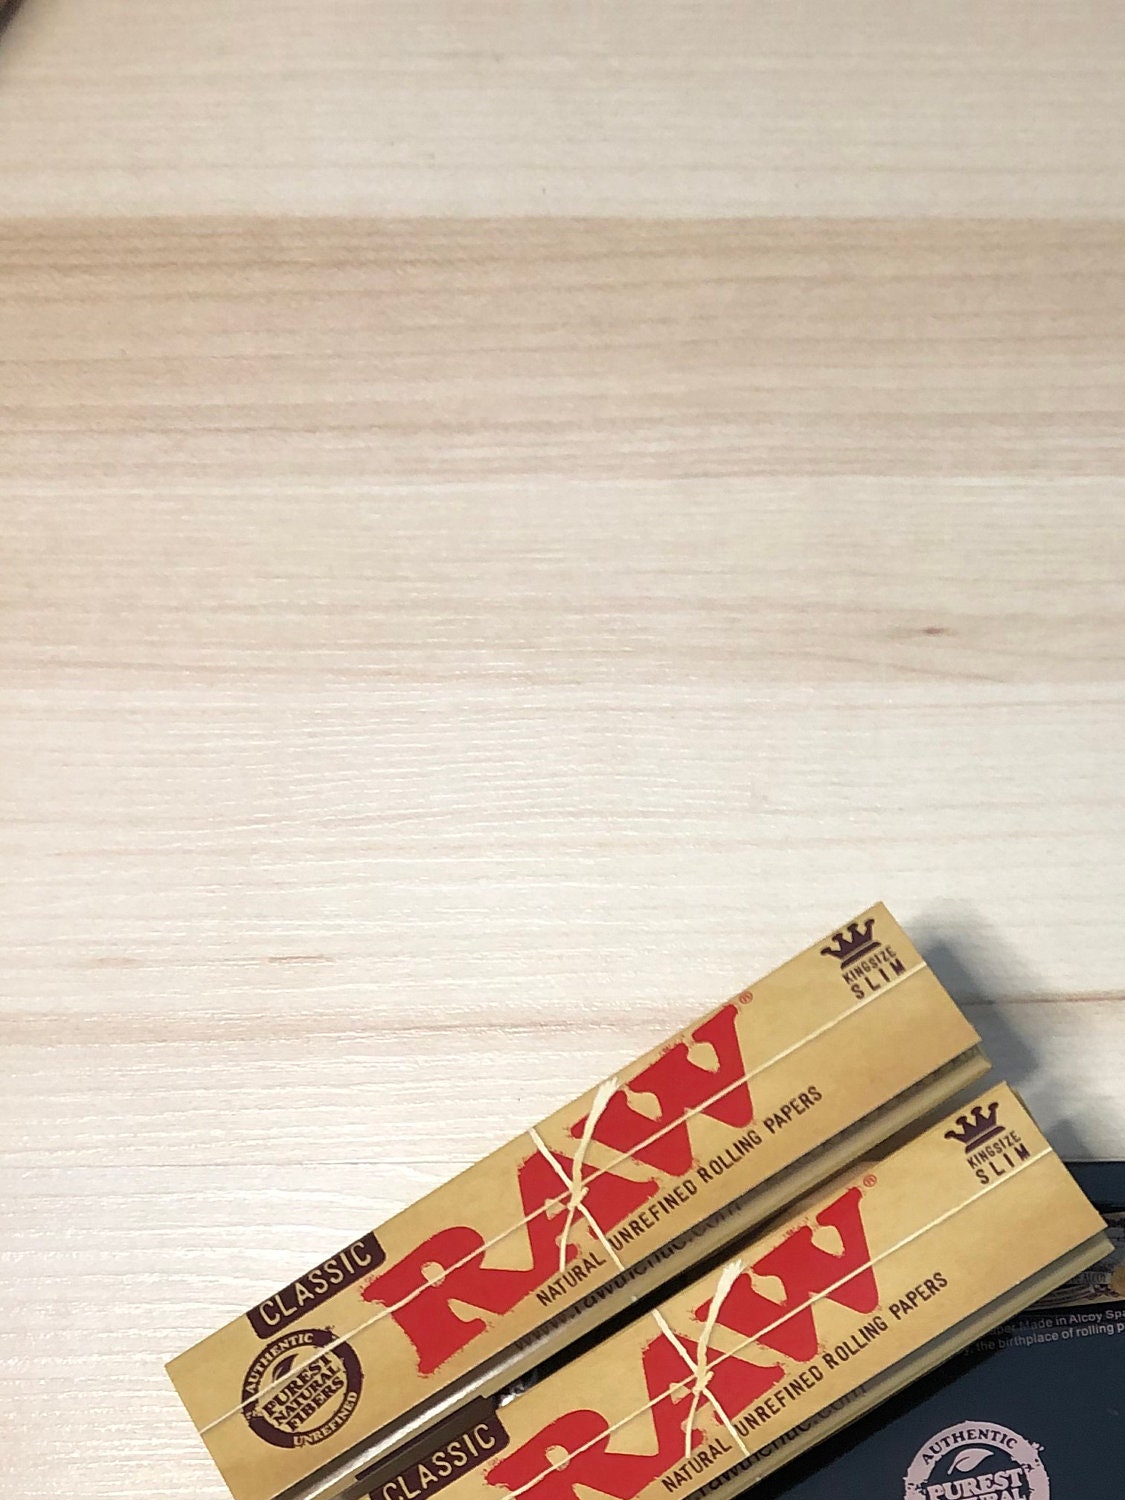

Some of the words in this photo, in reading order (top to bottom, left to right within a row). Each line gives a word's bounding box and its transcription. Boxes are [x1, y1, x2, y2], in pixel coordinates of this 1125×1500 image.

[842, 946, 897, 985] KINGSIZE
[851, 958, 906, 1000] SLIM
[966, 1130, 1022, 1170] KINGSIZE
[975, 1142, 1031, 1185] SLIM
[361, 1003, 754, 1378] RAW
[535, 1252, 607, 1307] NATURAL
[608, 1179, 698, 1252] UNREFINED
[696, 1130, 762, 1184] ROLLING
[763, 1086, 824, 1134] PAPERS
[259, 1241, 372, 1327] CLASSIC
[998, 1331, 1060, 1350] birthplace
[1062, 1328, 1076, 1339] of
[1076, 1322, 1115, 1338] rolling
[1055, 1315, 1068, 1326] in
[1069, 1311, 1103, 1327] Alcoy
[244, 1331, 314, 1395] AUTHENTIC
[262, 1351, 333, 1417] PUREST
[661, 1437, 733, 1493] NATURAL
[733, 1365, 825, 1437] UNREFINED
[821, 1314, 889, 1368] ROLLING
[889, 1271, 949, 1321] PAPERS
[273, 1364, 341, 1426] NATURAL
[285, 1376, 345, 1433] FIBERS
[292, 1391, 358, 1447] UNREFINED
[921, 1428, 1018, 1466] AUTHENTIC
